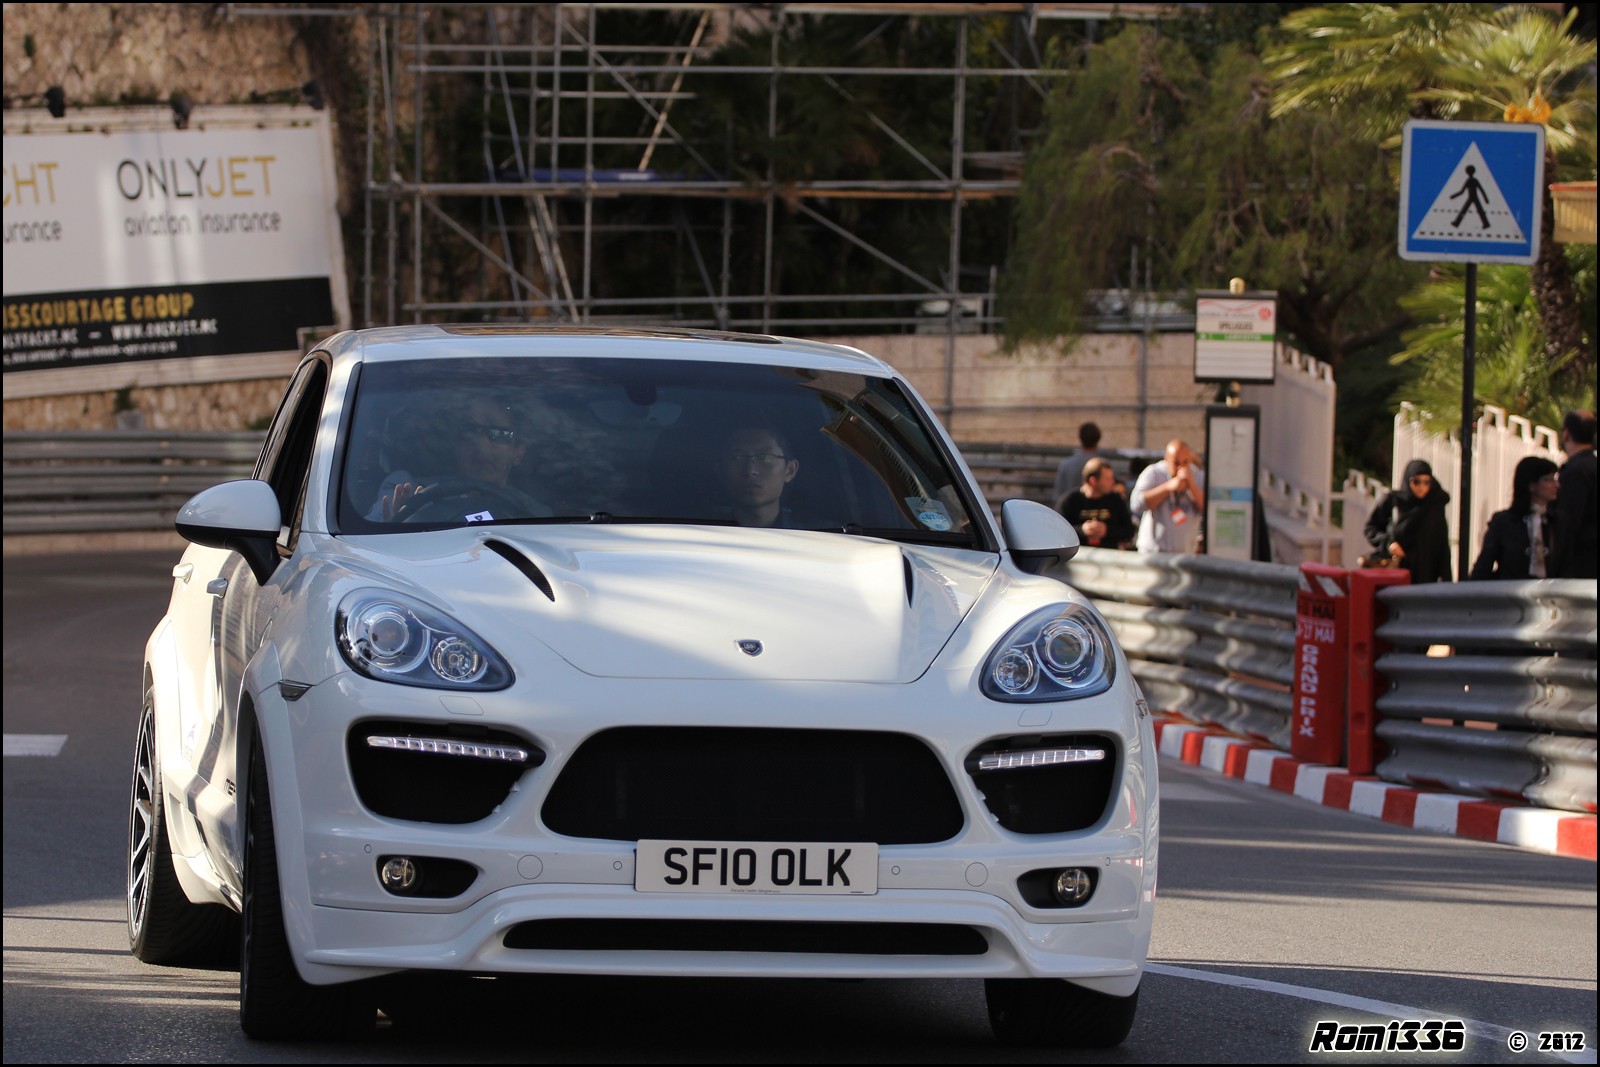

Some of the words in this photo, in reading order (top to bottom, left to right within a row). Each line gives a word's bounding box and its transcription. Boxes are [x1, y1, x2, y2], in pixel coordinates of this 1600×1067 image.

[116, 156, 277, 201] ONLYJET
[124, 211, 190, 237] aviation
[200, 209, 281, 233] insurance
[130, 292, 195, 320] GROUP
[1314, 624, 1336, 644] MAI
[1301, 643, 1319, 694] GRAND
[1299, 695, 1316, 738] PRIX
[663, 847, 757, 886] SF10
[771, 847, 852, 887] OLK
